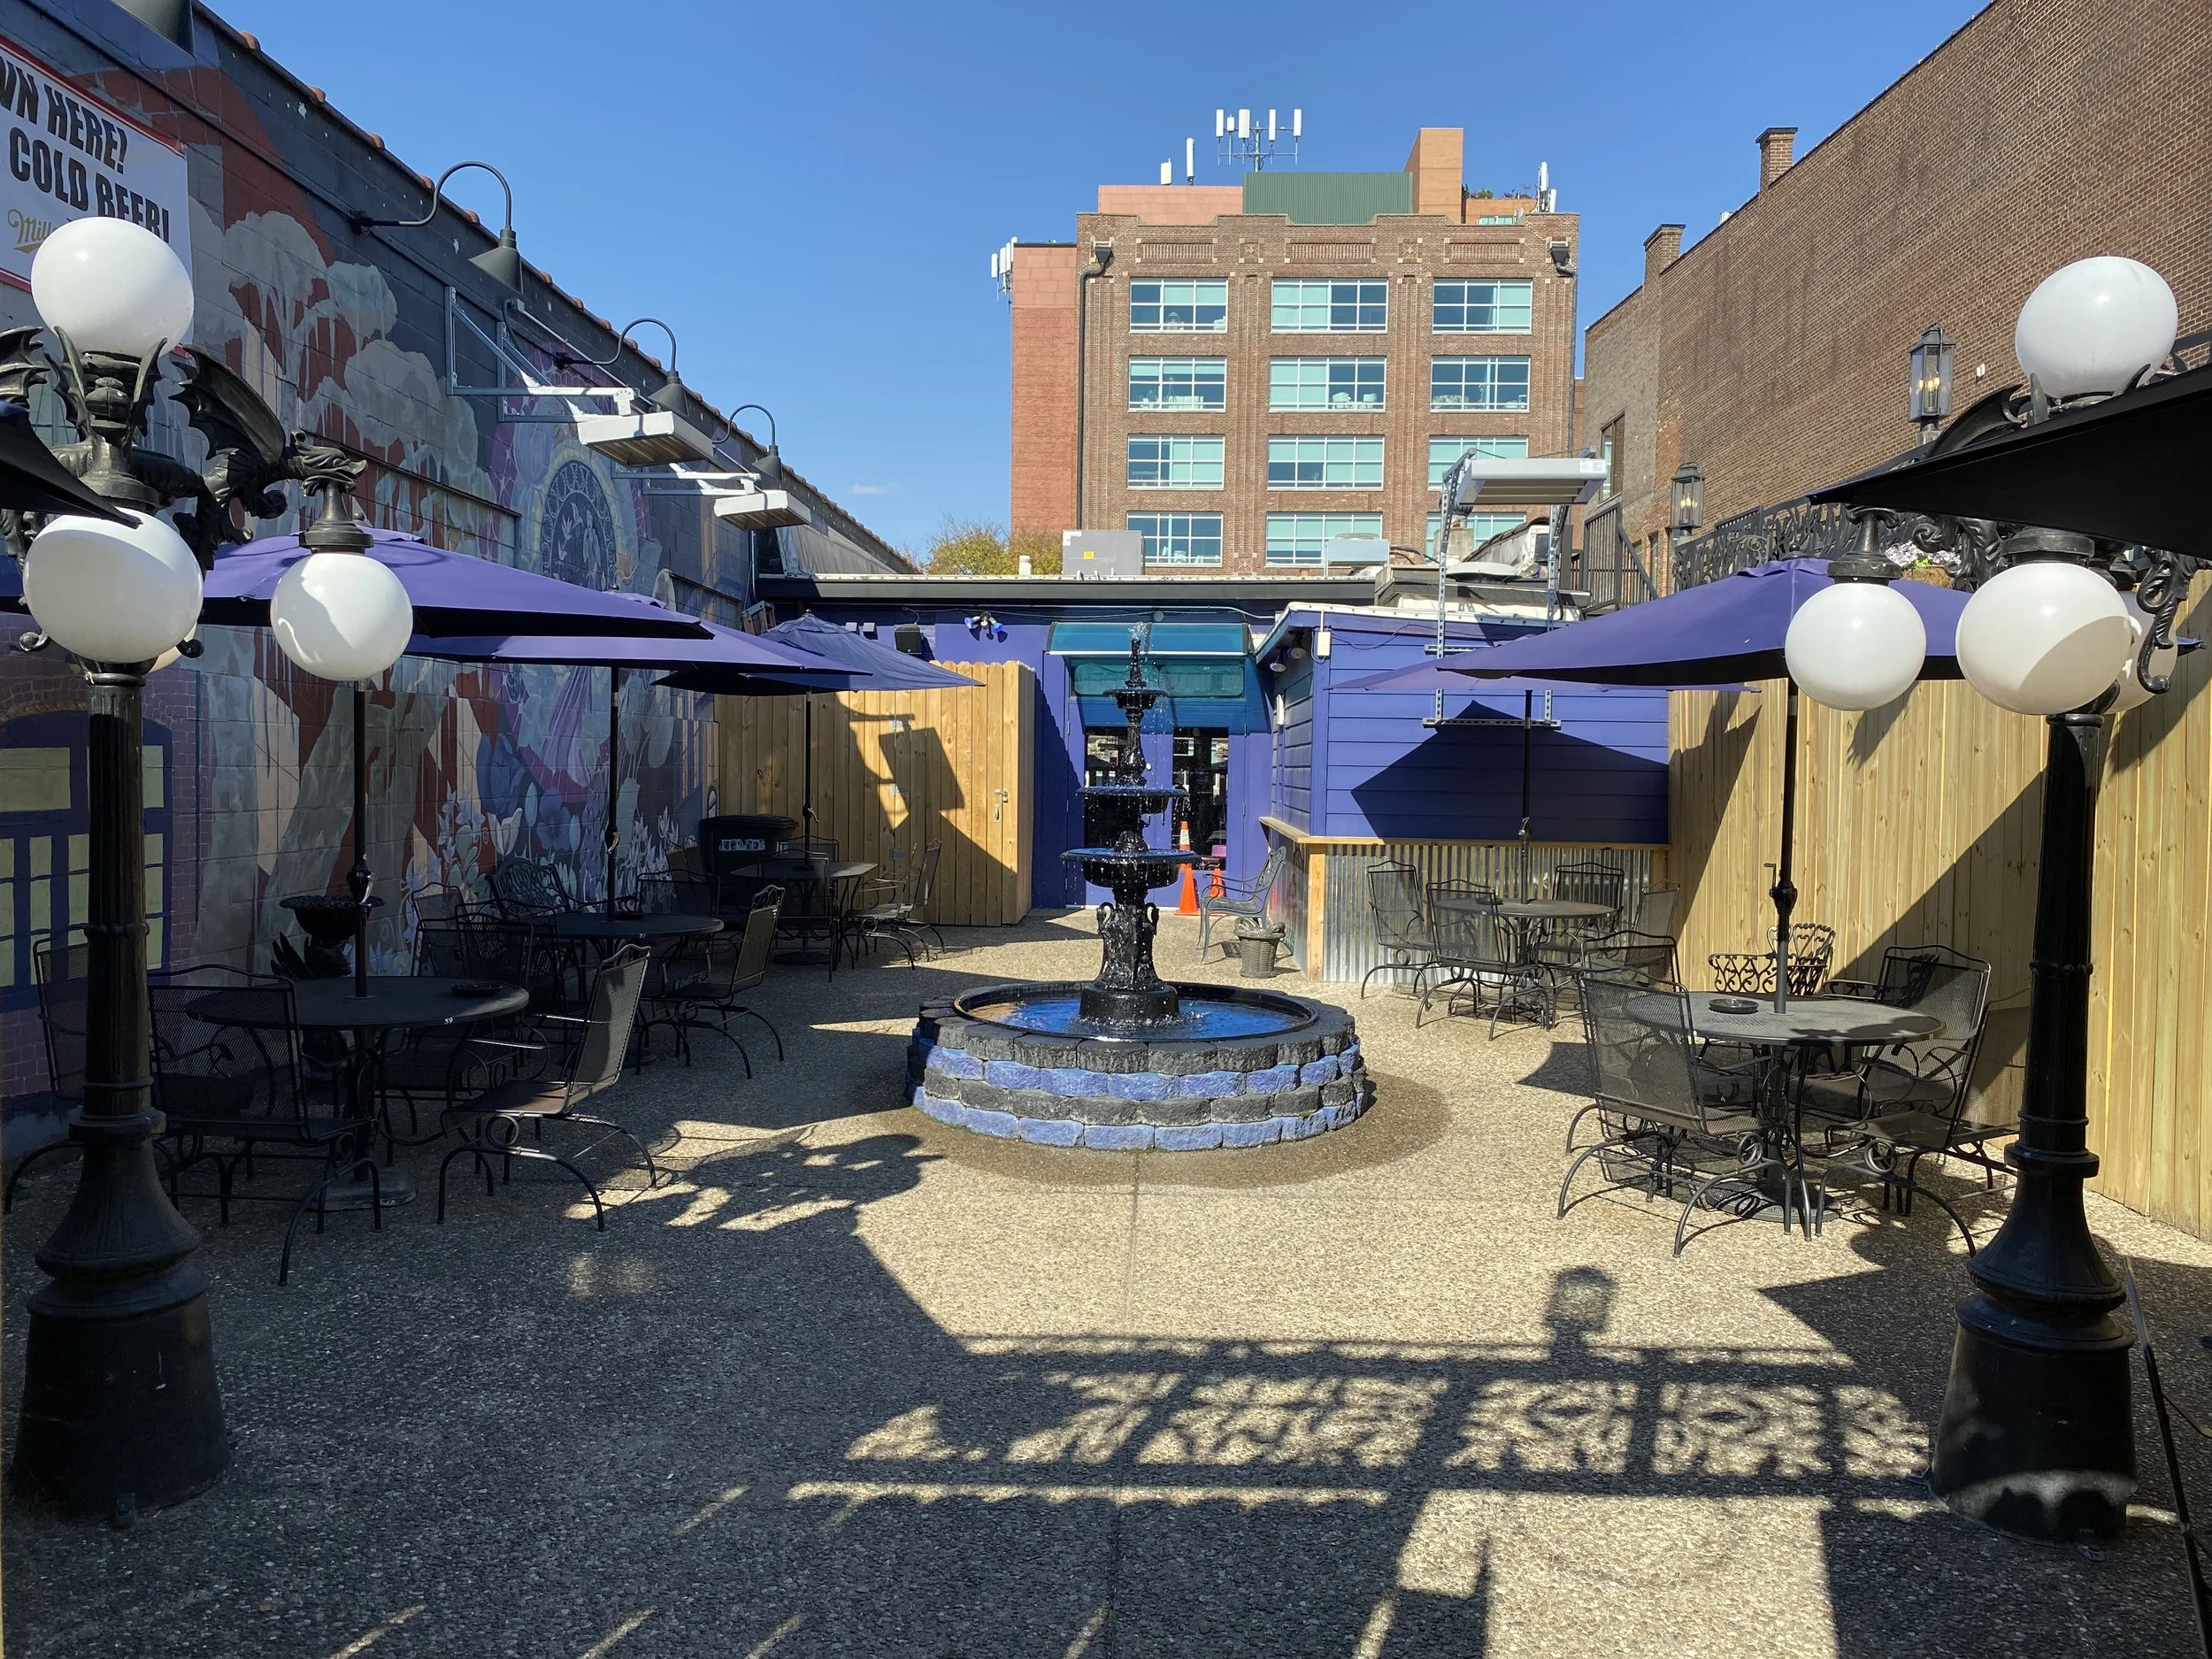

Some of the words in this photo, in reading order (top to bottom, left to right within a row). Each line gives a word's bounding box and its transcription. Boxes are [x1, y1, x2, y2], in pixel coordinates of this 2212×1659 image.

[44, 83, 127, 174] HERE!
[8, 209, 54, 243] Mill
[10, 127, 88, 211] COLD
[95, 172, 169, 243] BEER!
